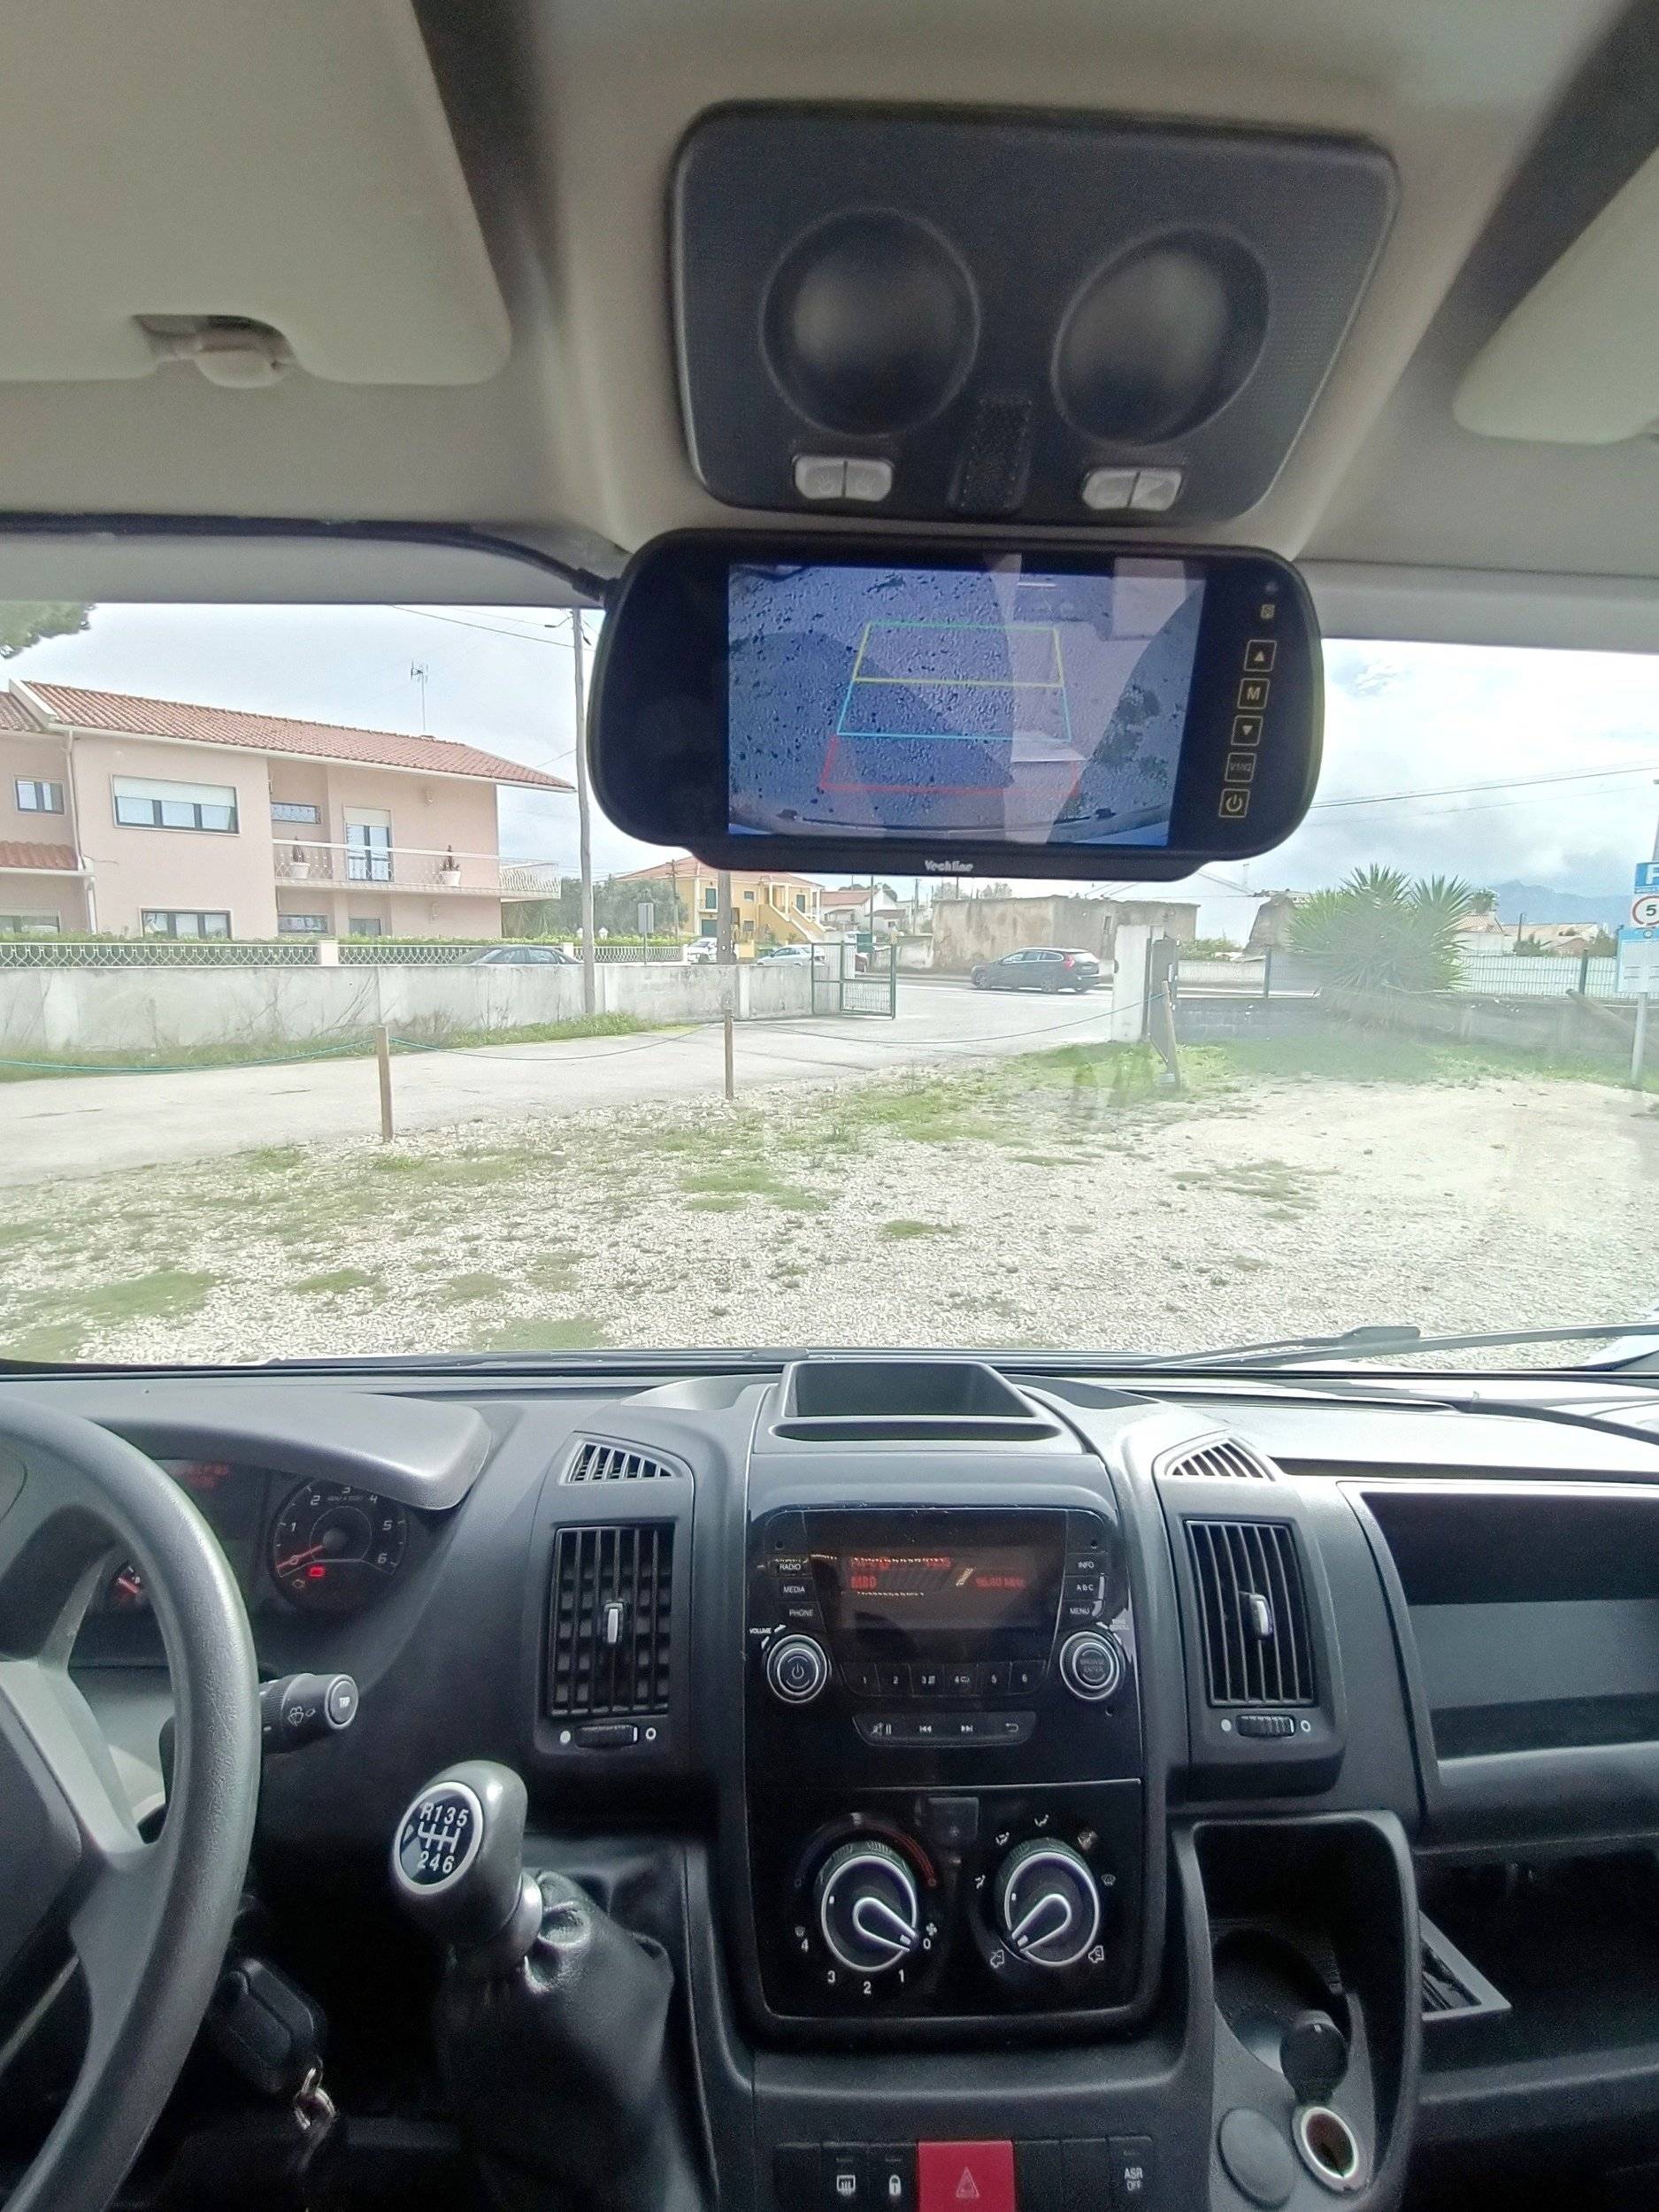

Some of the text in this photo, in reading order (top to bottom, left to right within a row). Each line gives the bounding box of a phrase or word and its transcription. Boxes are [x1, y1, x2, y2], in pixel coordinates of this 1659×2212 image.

[1248, 687, 1260, 700] M
[1646, 904, 1657, 916] 5
[310, 1495, 320, 1505] 2
[370, 1495, 378, 1504] 4
[291, 1523, 296, 1532] 1
[382, 1520, 392, 1531] 5
[378, 1553, 388, 1564] 6
[894, 1676, 899, 1685] 2
[921, 1676, 927, 1685] 3
[991, 1675, 997, 1684] 5
[1022, 1674, 1028, 1683] 6
[800, 1939, 810, 1952] 4
[827, 1970, 836, 1984] 3
[898, 1969, 905, 1983] 1
[863, 1980, 872, 1995] 2
[1124, 2167, 1143, 2179] ASR
[1126, 2179, 1141, 2191] OFF
